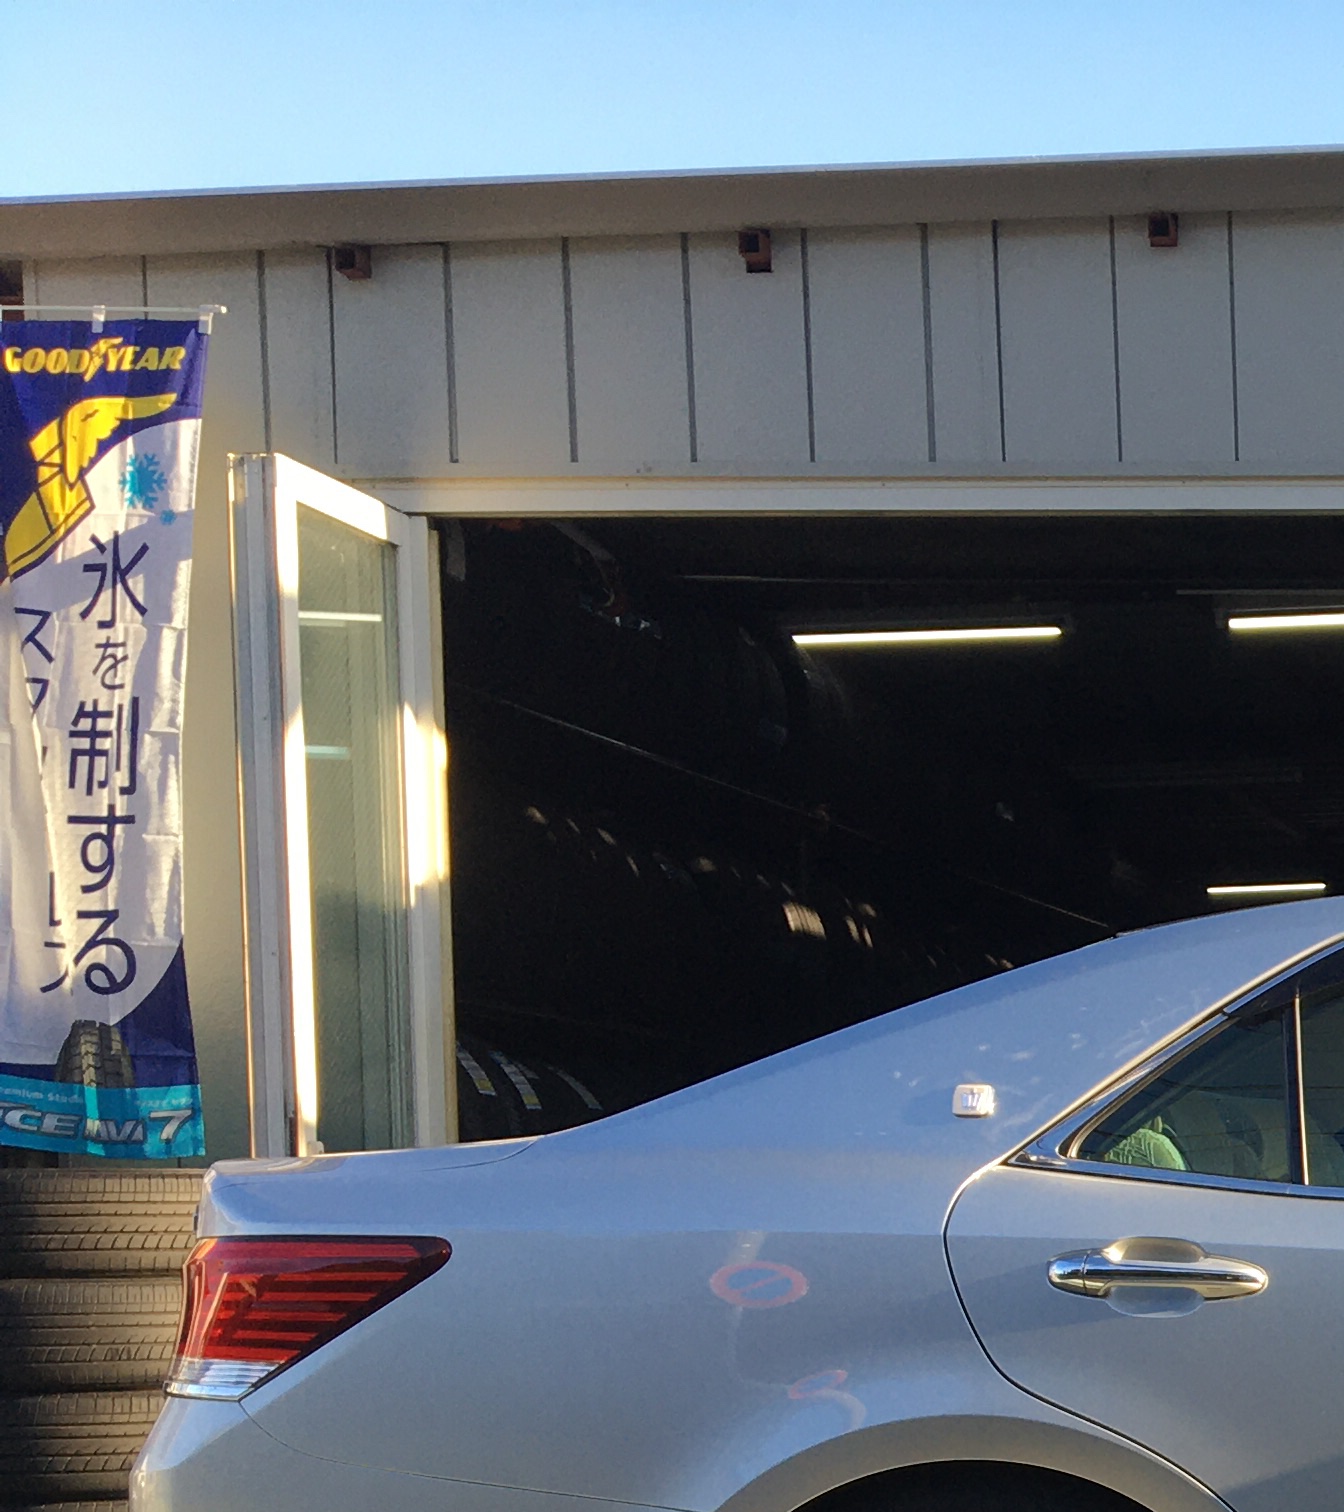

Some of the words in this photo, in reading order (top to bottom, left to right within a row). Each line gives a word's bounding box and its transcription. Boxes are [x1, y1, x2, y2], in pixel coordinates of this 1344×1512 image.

[4, 346, 187, 374] GOODYEAR
[67, 530, 150, 997] 氷を制する
[0, 1107, 83, 1138] CE
[150, 1109, 193, 1140] 7
